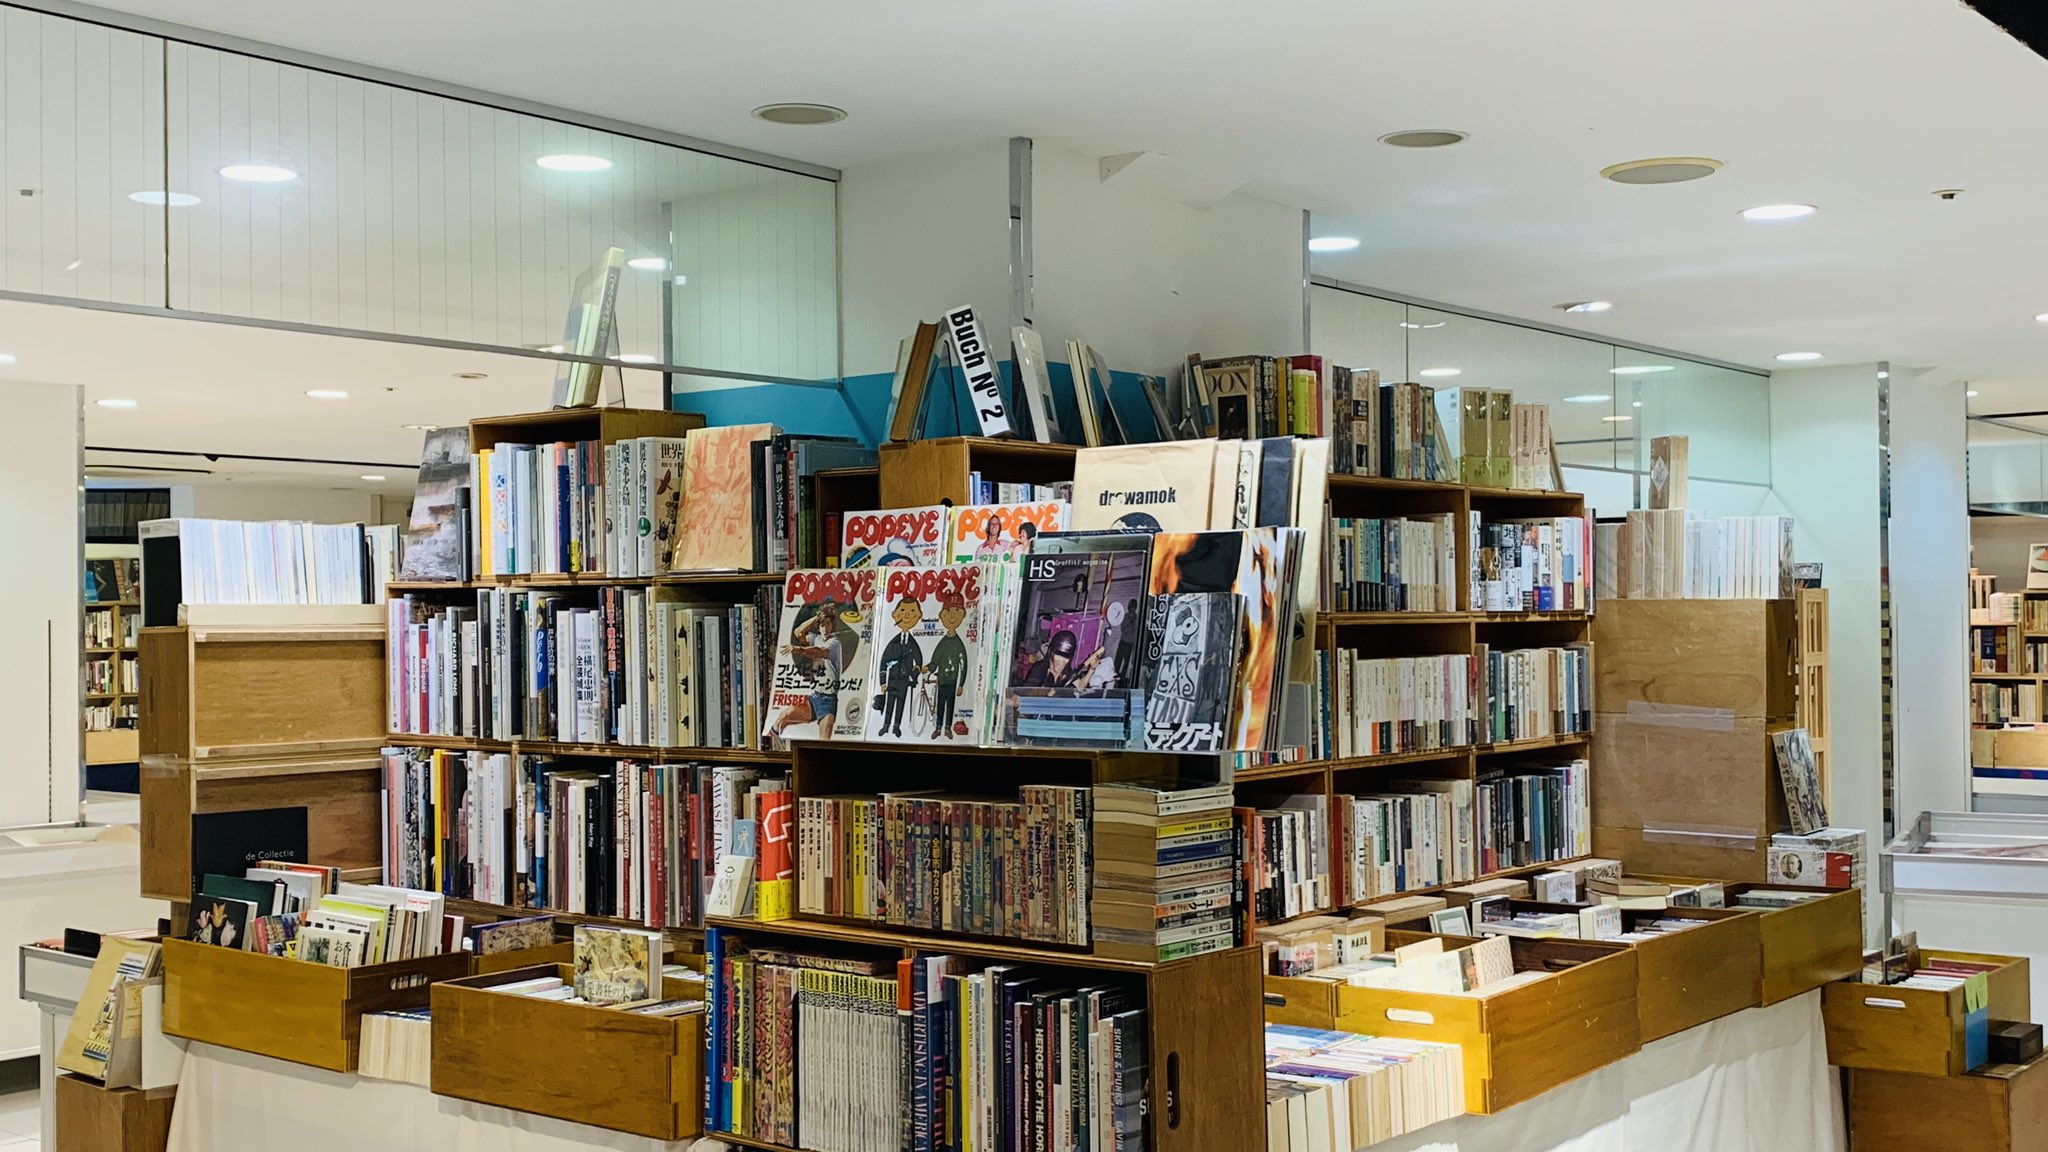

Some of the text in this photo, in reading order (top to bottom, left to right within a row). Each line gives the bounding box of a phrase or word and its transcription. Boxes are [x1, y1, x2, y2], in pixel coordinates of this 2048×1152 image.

[950, 308, 986, 369] Buch
[980, 404, 1004, 423] 2
[845, 510, 939, 546] POPEYE
[957, 504, 1059, 542] POPEYE
[786, 570, 876, 603] POPEYE
[886, 566, 981, 602] POPEYE
[1029, 560, 1056, 578] HS
[713, 771, 722, 827] KAWASE
[245, 849, 294, 861] de Collectie
[932, 837, 940, 905] 全都市カタログ
[1065, 821, 1075, 891] 全都市カタログ
[913, 990, 928, 1152] ADVERTISING IN AMERICA
[1035, 1028, 1044, 1078] HEROES
[1070, 1010, 1079, 1111] STRANGE RITUAL
[1114, 1061, 1122, 1069] &
[1035, 1080, 1044, 1097] OF
[1078, 1048, 1087, 1126] AMERICAN DENIM
[1114, 1072, 1123, 1105] PUNKS
[1035, 1099, 1044, 1123] THE
[1035, 1125, 1044, 1152] HOR
[1115, 1121, 1124, 1150] GAVIN
